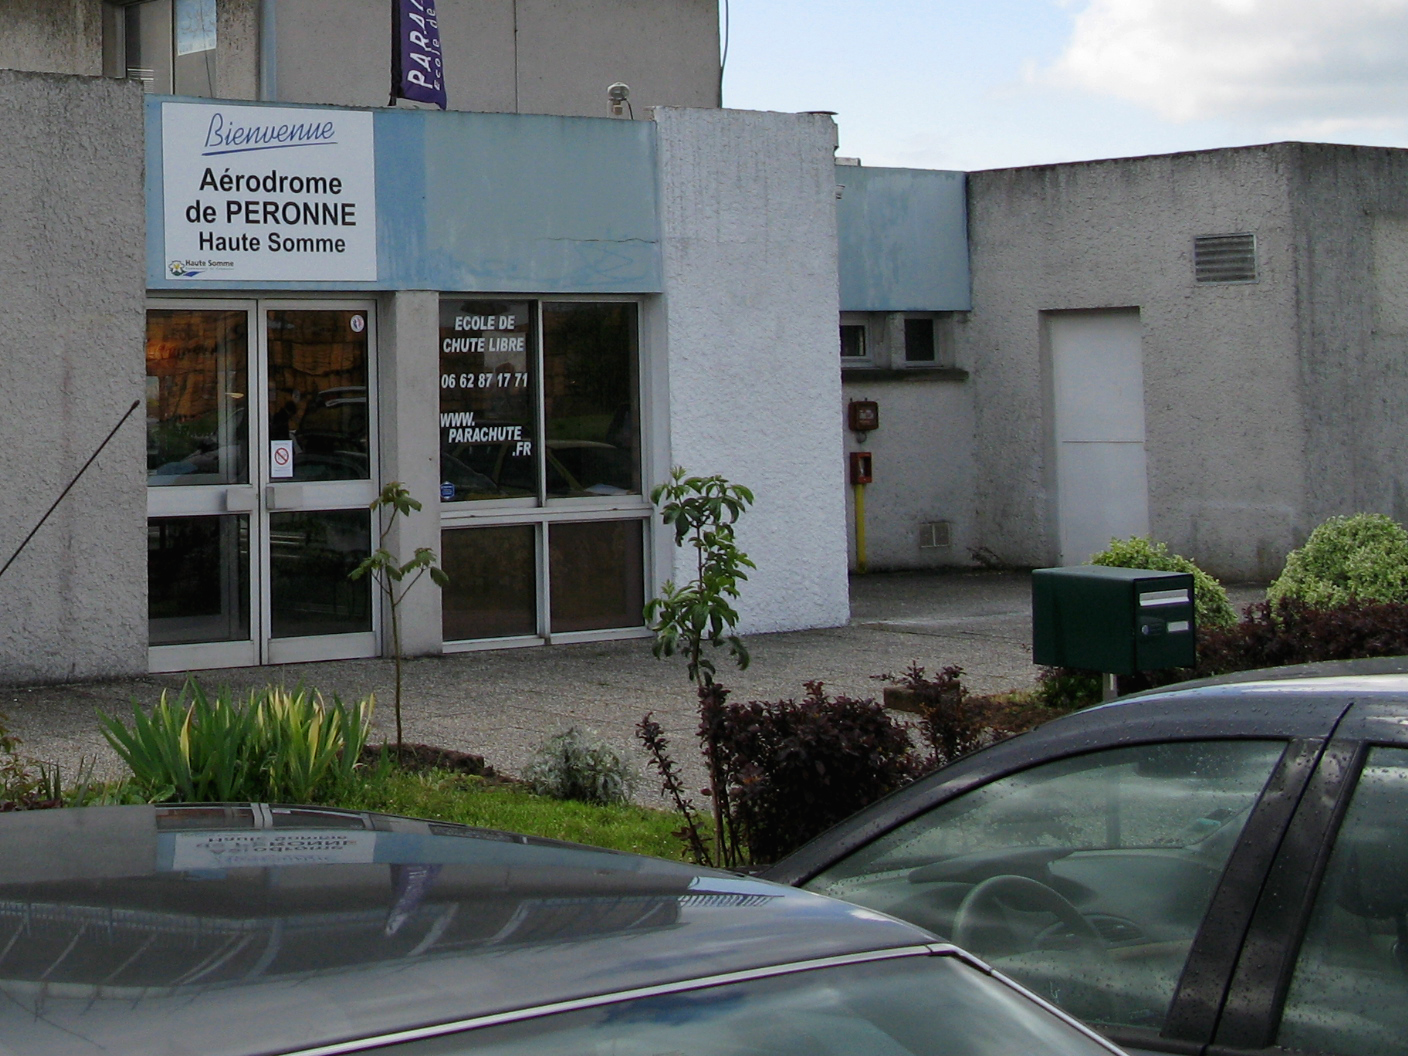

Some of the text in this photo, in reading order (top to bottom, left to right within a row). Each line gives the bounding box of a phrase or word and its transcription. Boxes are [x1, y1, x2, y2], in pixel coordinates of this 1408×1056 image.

[426, 8, 438, 29] de
[432, 39, 441, 91] Ecole
[204, 112, 336, 148] Bienvenue
[199, 167, 342, 194] Aérodrome
[185, 200, 357, 226] de PERONNE
[199, 231, 346, 253] Haute Somme
[185, 259, 234, 267] Haute Somme
[455, 315, 516, 331] ECOLE DE
[443, 337, 525, 353] CHUTE LIBRE
[441, 372, 528, 389] 06 62 87 17 71
[440, 411, 476, 428] WWW.
[448, 425, 523, 444] PARACHUTE
[512, 441, 532, 457] .FR
